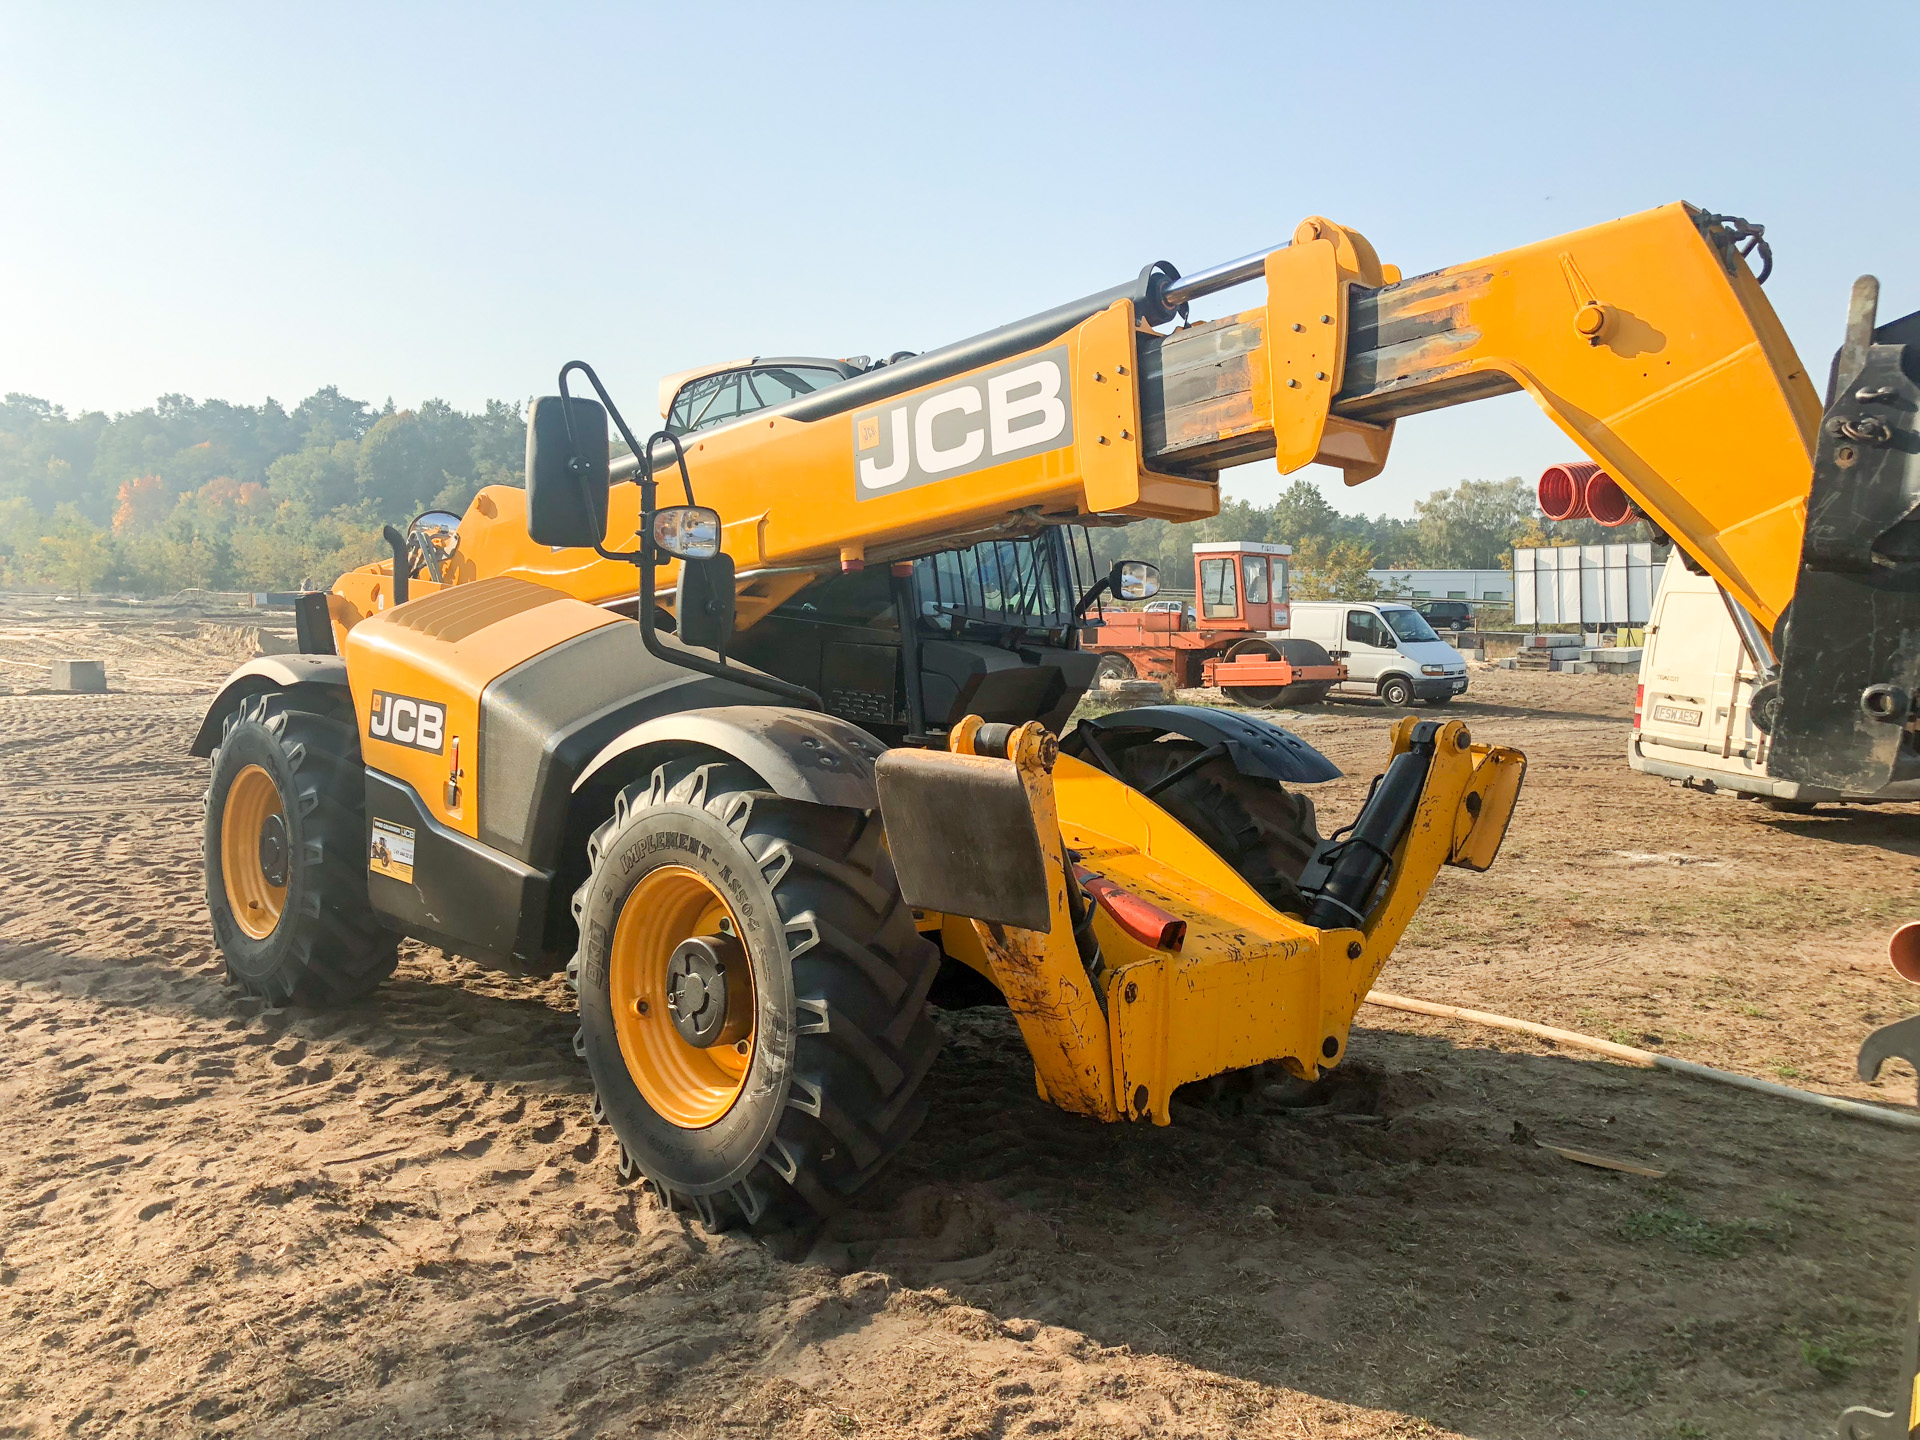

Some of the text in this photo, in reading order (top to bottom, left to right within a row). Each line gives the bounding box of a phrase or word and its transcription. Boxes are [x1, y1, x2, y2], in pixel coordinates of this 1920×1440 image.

[860, 361, 1066, 489] JCB
[863, 427, 876, 440] JCB
[371, 697, 444, 749] JCB
[401, 828, 415, 839] JCB
